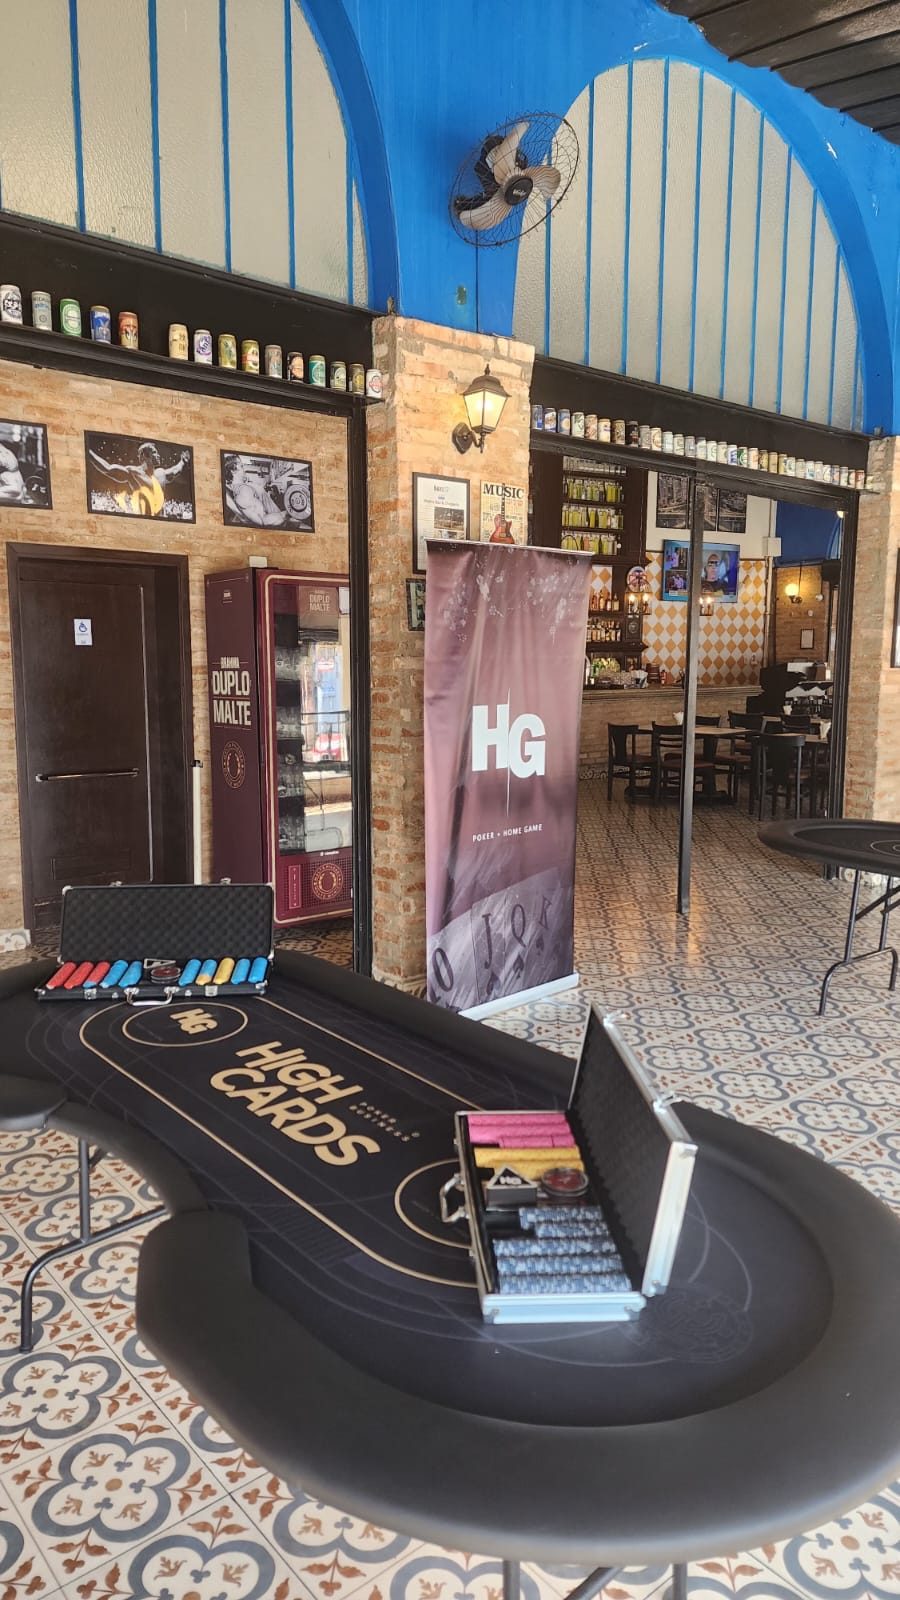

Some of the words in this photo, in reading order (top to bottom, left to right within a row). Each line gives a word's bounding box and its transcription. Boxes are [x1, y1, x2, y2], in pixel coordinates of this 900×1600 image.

[483, 483, 525, 499] MUSIC
[212, 670, 250, 696] DUPLO
[213, 699, 252, 726] MALTE
[472, 704, 546, 779] HG
[472, 831, 495, 843] POKER
[503, 827, 523, 838] HOME
[523, 823, 543, 834] GAME
[482, 913, 493, 970] J
[511, 904, 526, 948] Q
[169, 1007, 218, 1035] HG
[235, 1041, 364, 1105] HIGH
[210, 1067, 381, 1166] CARDS
